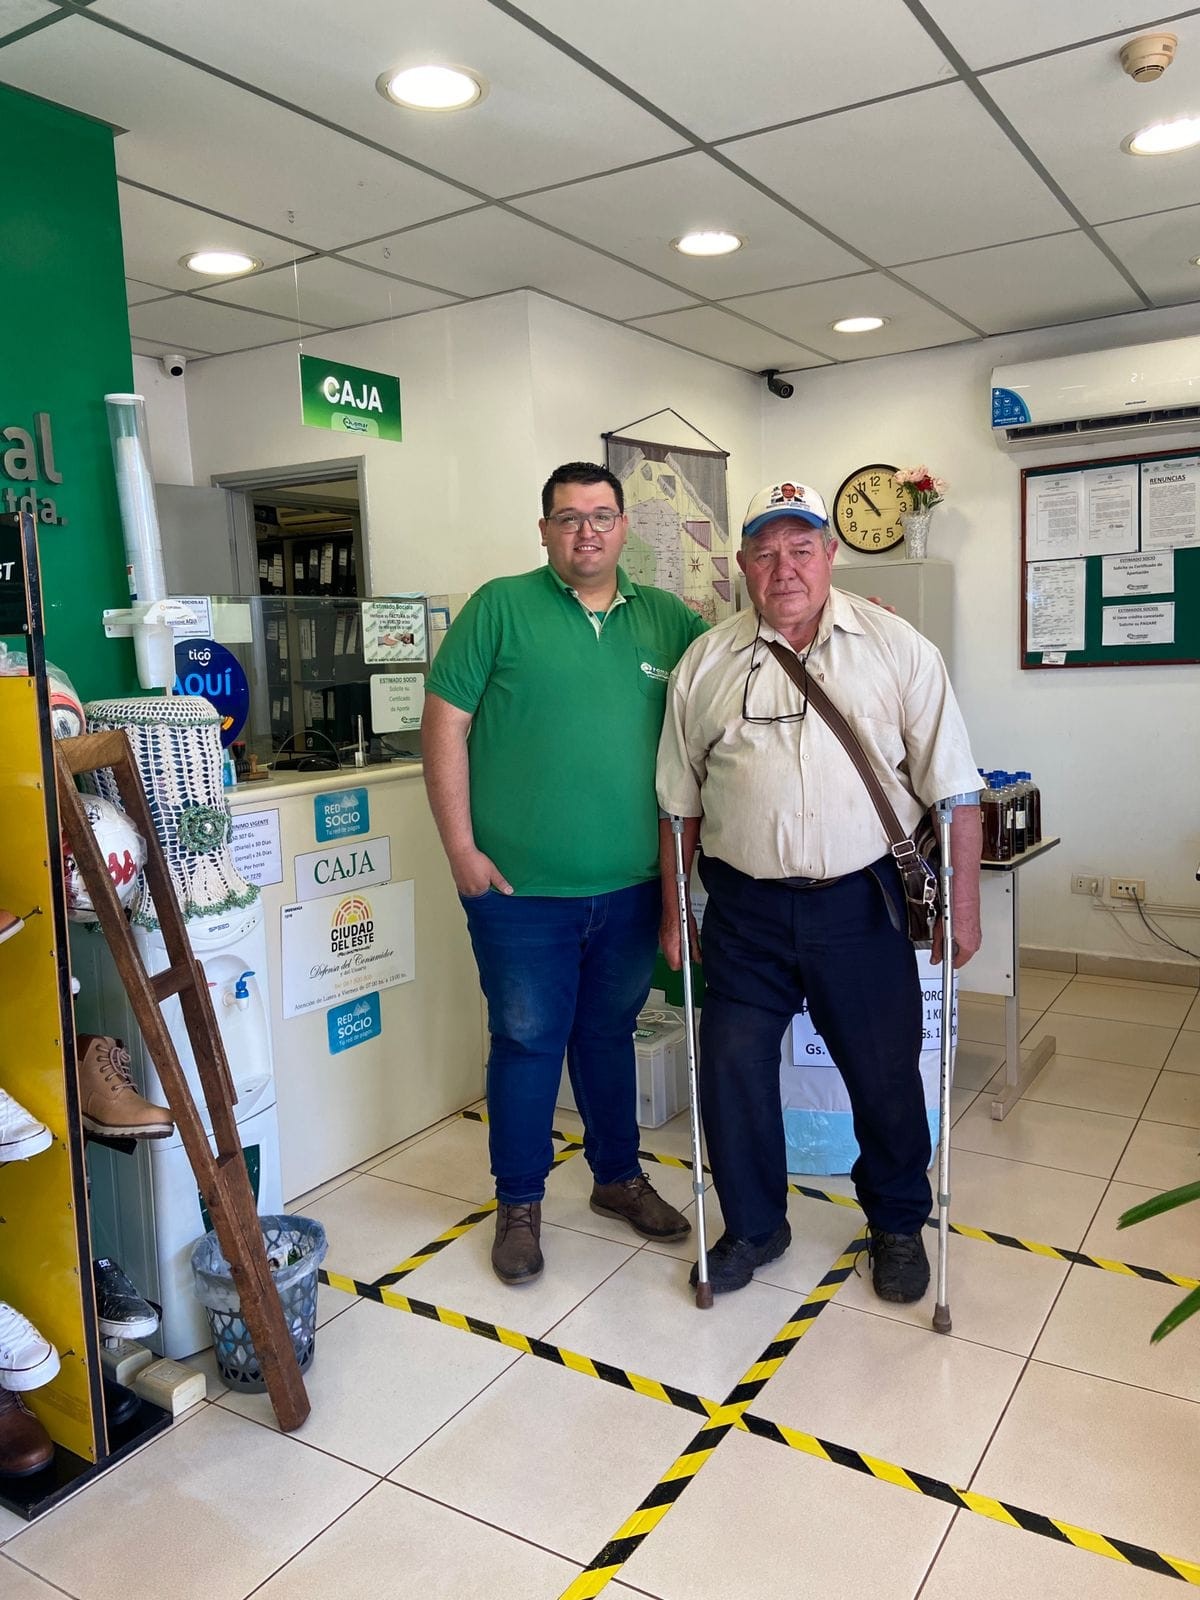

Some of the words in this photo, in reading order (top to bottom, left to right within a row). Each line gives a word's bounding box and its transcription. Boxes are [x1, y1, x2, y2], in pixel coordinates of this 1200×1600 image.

[323, 376, 383, 413] CAJA
[3, 412, 63, 484] al
[869, 476, 881, 487] 12
[887, 478, 892, 488] 1
[1149, 474, 1186, 485] RENUNCIAS
[857, 481, 866, 492] 11
[846, 493, 859, 504] 10
[896, 487, 904, 499] 2
[899, 501, 907, 512] 3
[845, 507, 853, 518] 9
[849, 521, 857, 532] 8
[895, 517, 903, 527] 4
[860, 530, 868, 541] 7
[873, 532, 881, 543] 6
[886, 527, 894, 538] 5
[172, 667, 232, 696] AQUÍ
[324, 804, 341, 815] RED
[250, 819, 269, 828] VIGENTE
[325, 812, 360, 828] SOCIO
[314, 850, 376, 885] CAJA
[331, 920, 374, 942] CIUDAD
[331, 940, 350, 952] DEL
[352, 932, 374, 947] ESTE
[309, 963, 339, 980] Defensa
[340, 958, 352, 970] del
[354, 948, 394, 966] Consumidor
[337, 1013, 353, 1027] RED
[337, 1016, 372, 1039] SOCIO
[806, 1043, 825, 1055] Gs.
